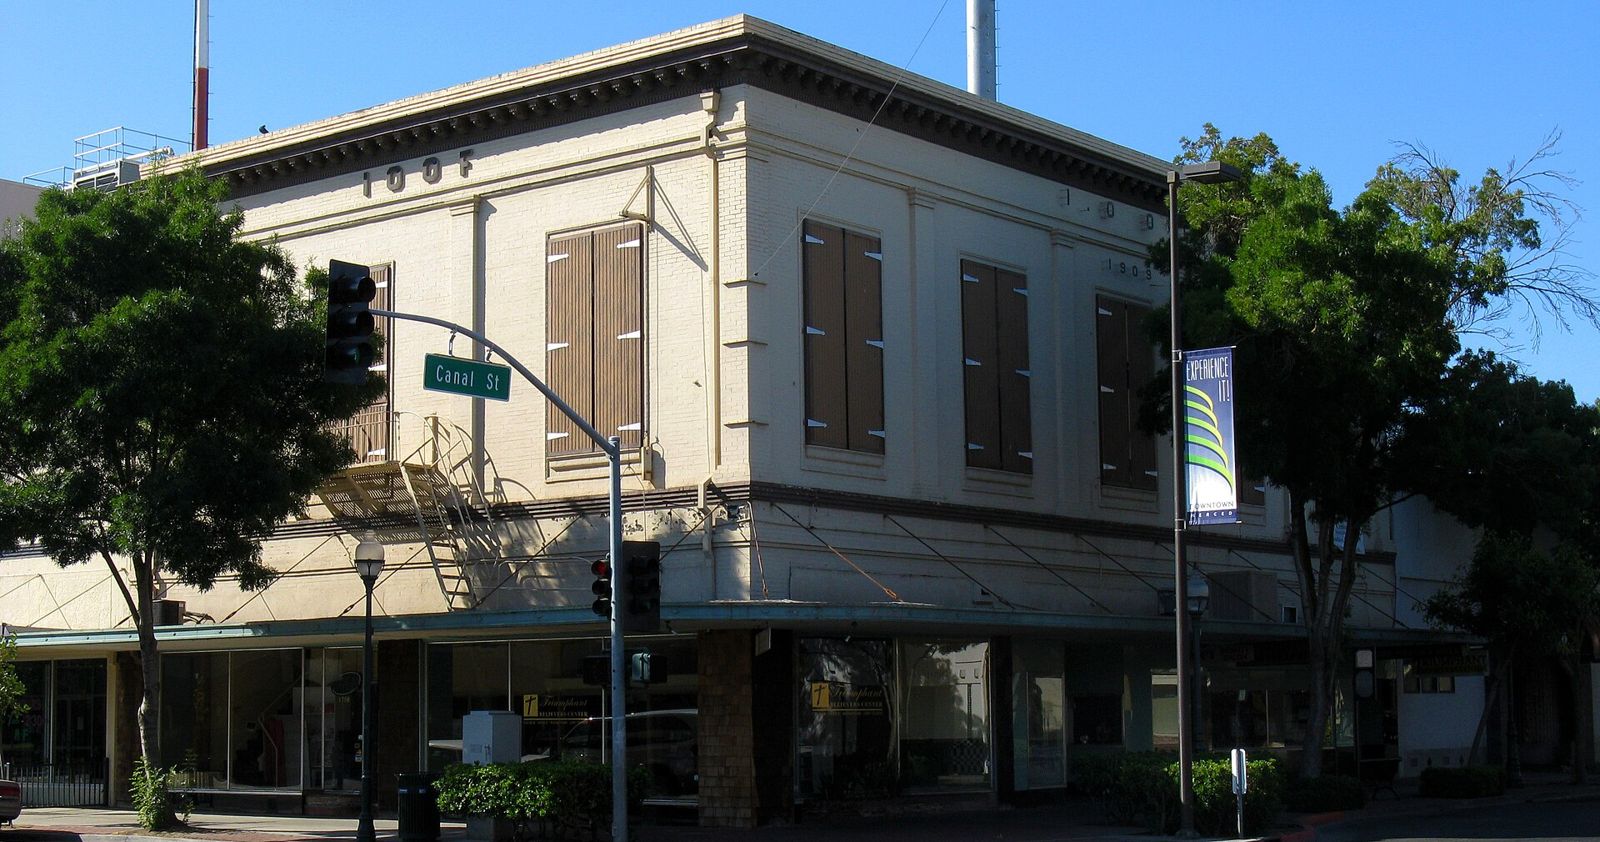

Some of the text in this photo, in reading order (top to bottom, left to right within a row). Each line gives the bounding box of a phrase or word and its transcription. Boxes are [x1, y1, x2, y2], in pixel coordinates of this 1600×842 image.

[436, 364, 500, 391] Canal St
[1187, 356, 1229, 381] EXPERIENCE
[1218, 380, 1230, 402] IT!
